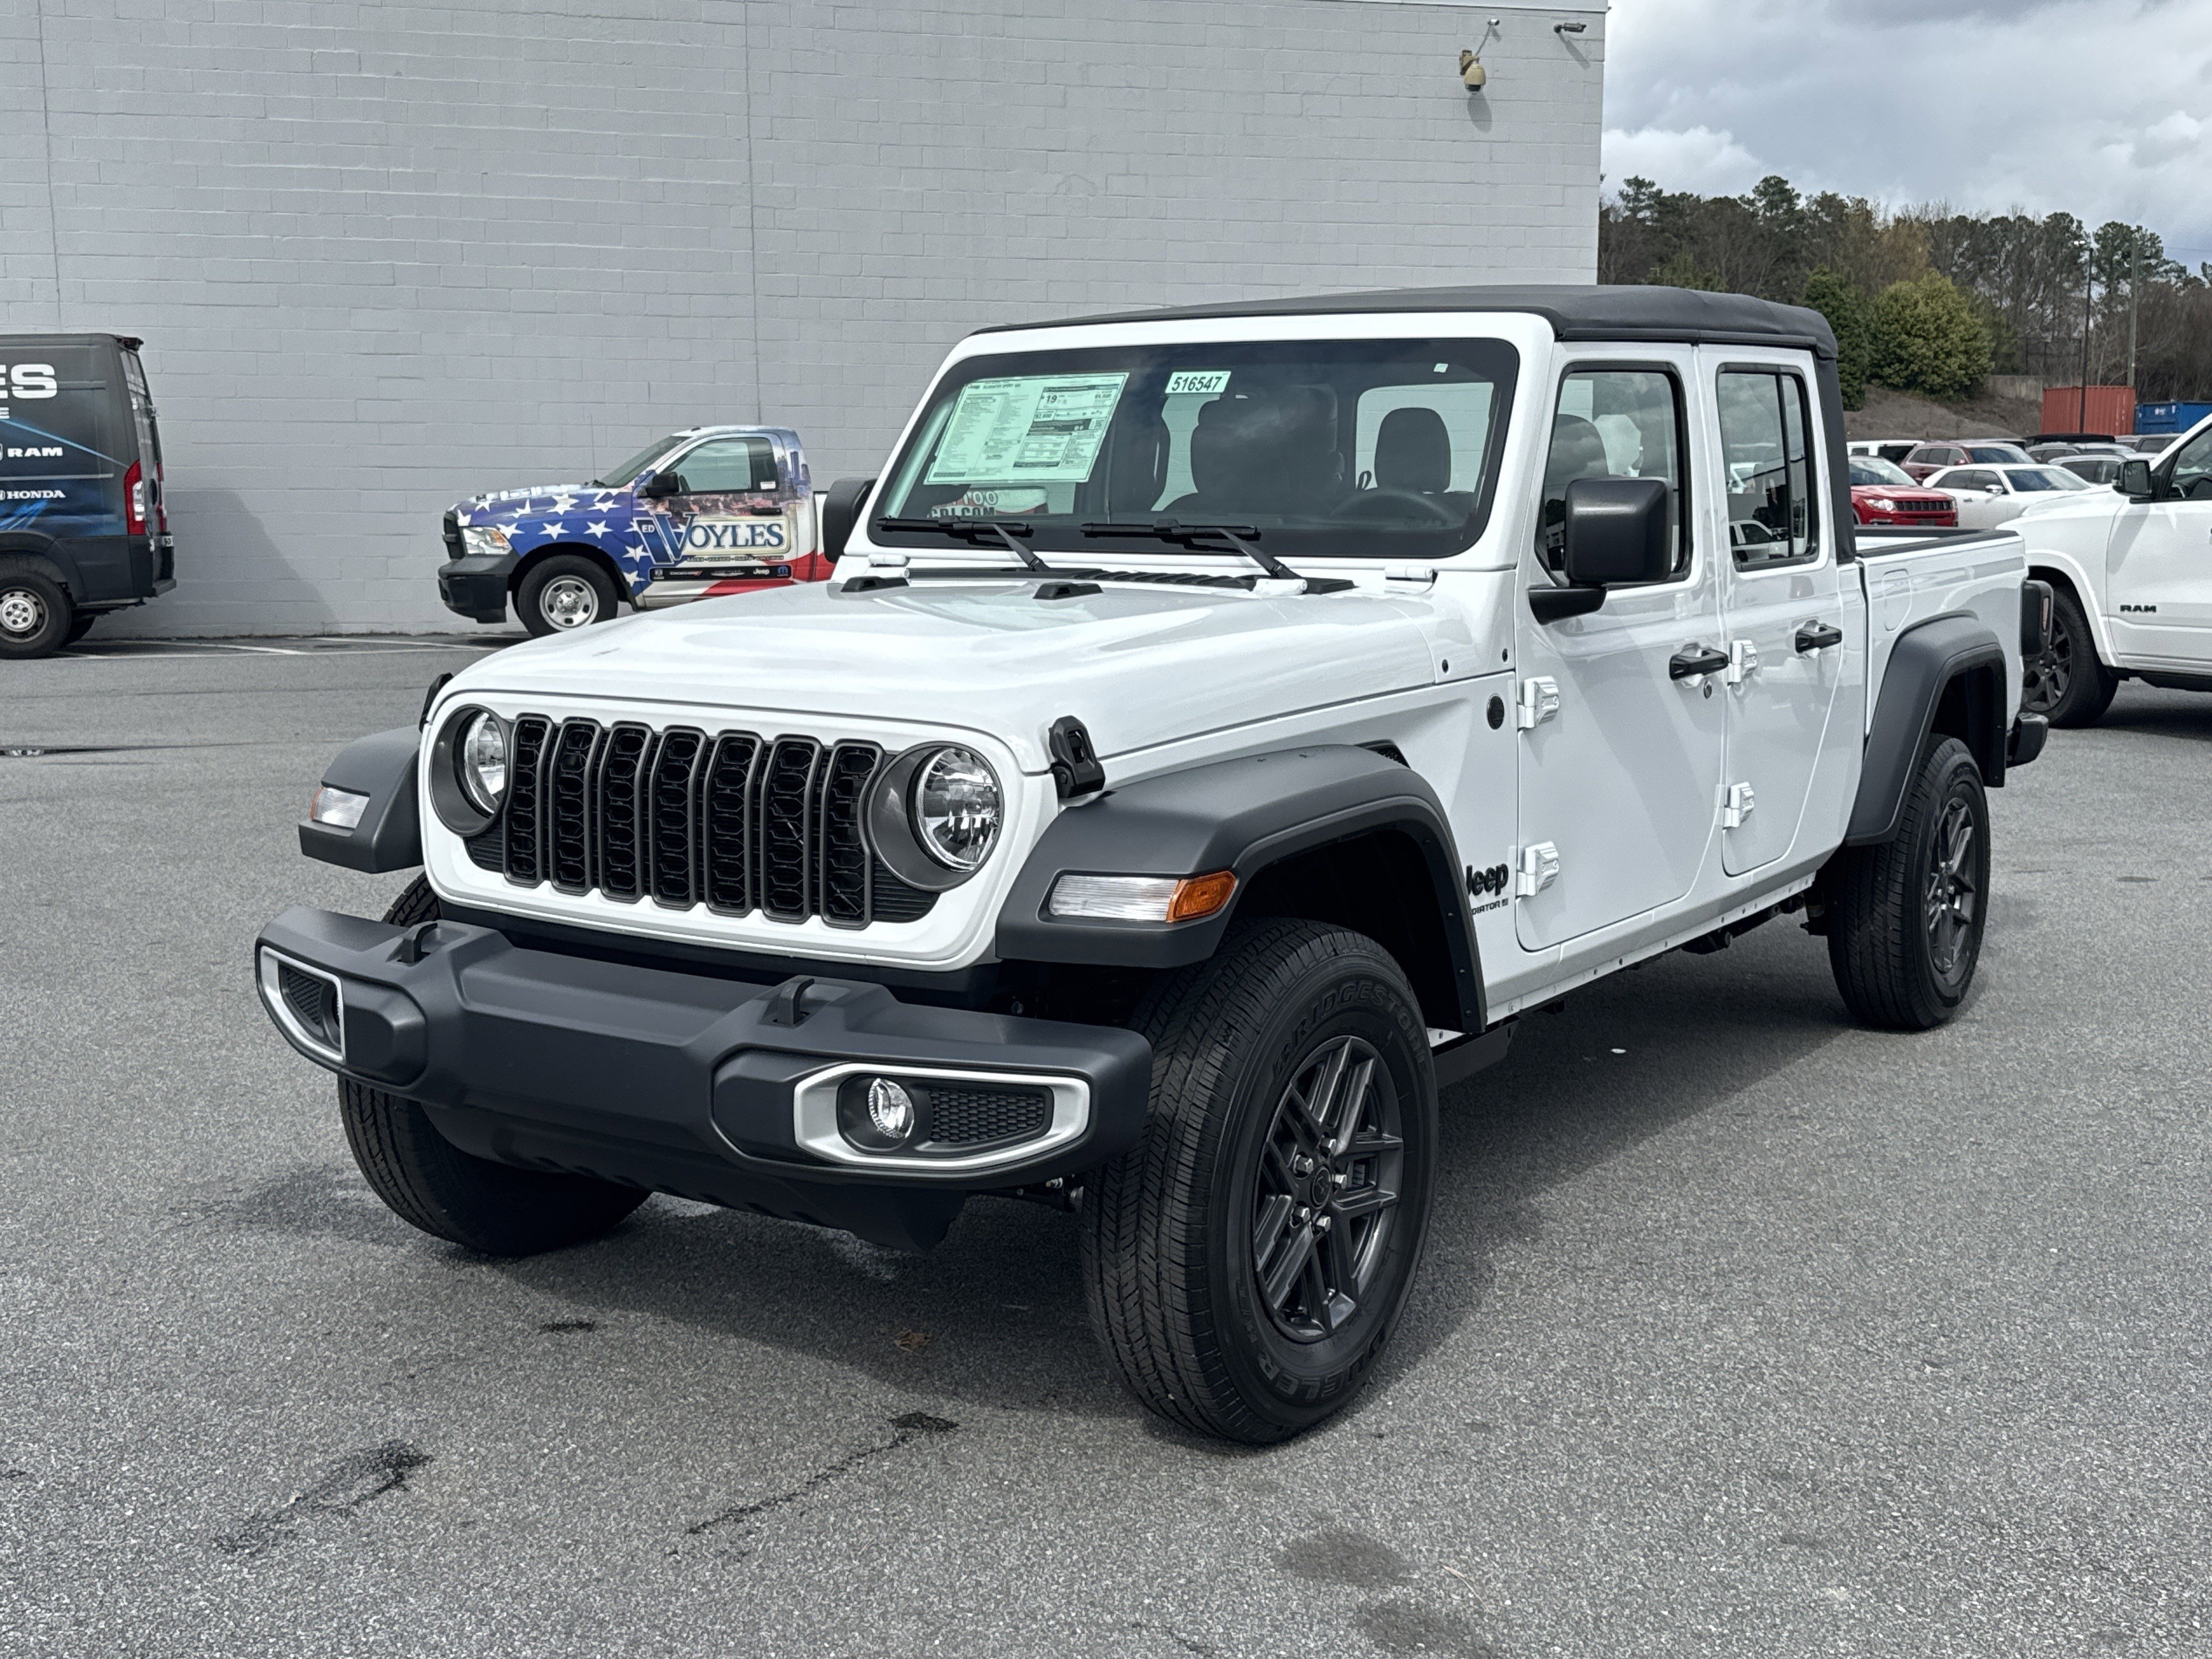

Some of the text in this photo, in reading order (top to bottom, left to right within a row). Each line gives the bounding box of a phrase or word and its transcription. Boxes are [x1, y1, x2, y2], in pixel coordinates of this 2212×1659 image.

[0, 364, 57, 399] S
[1172, 376, 1222, 391] 516547
[8, 447, 63, 458] RAM
[7, 490, 66, 499] HONDA
[642, 512, 784, 561] ED VOYLES
